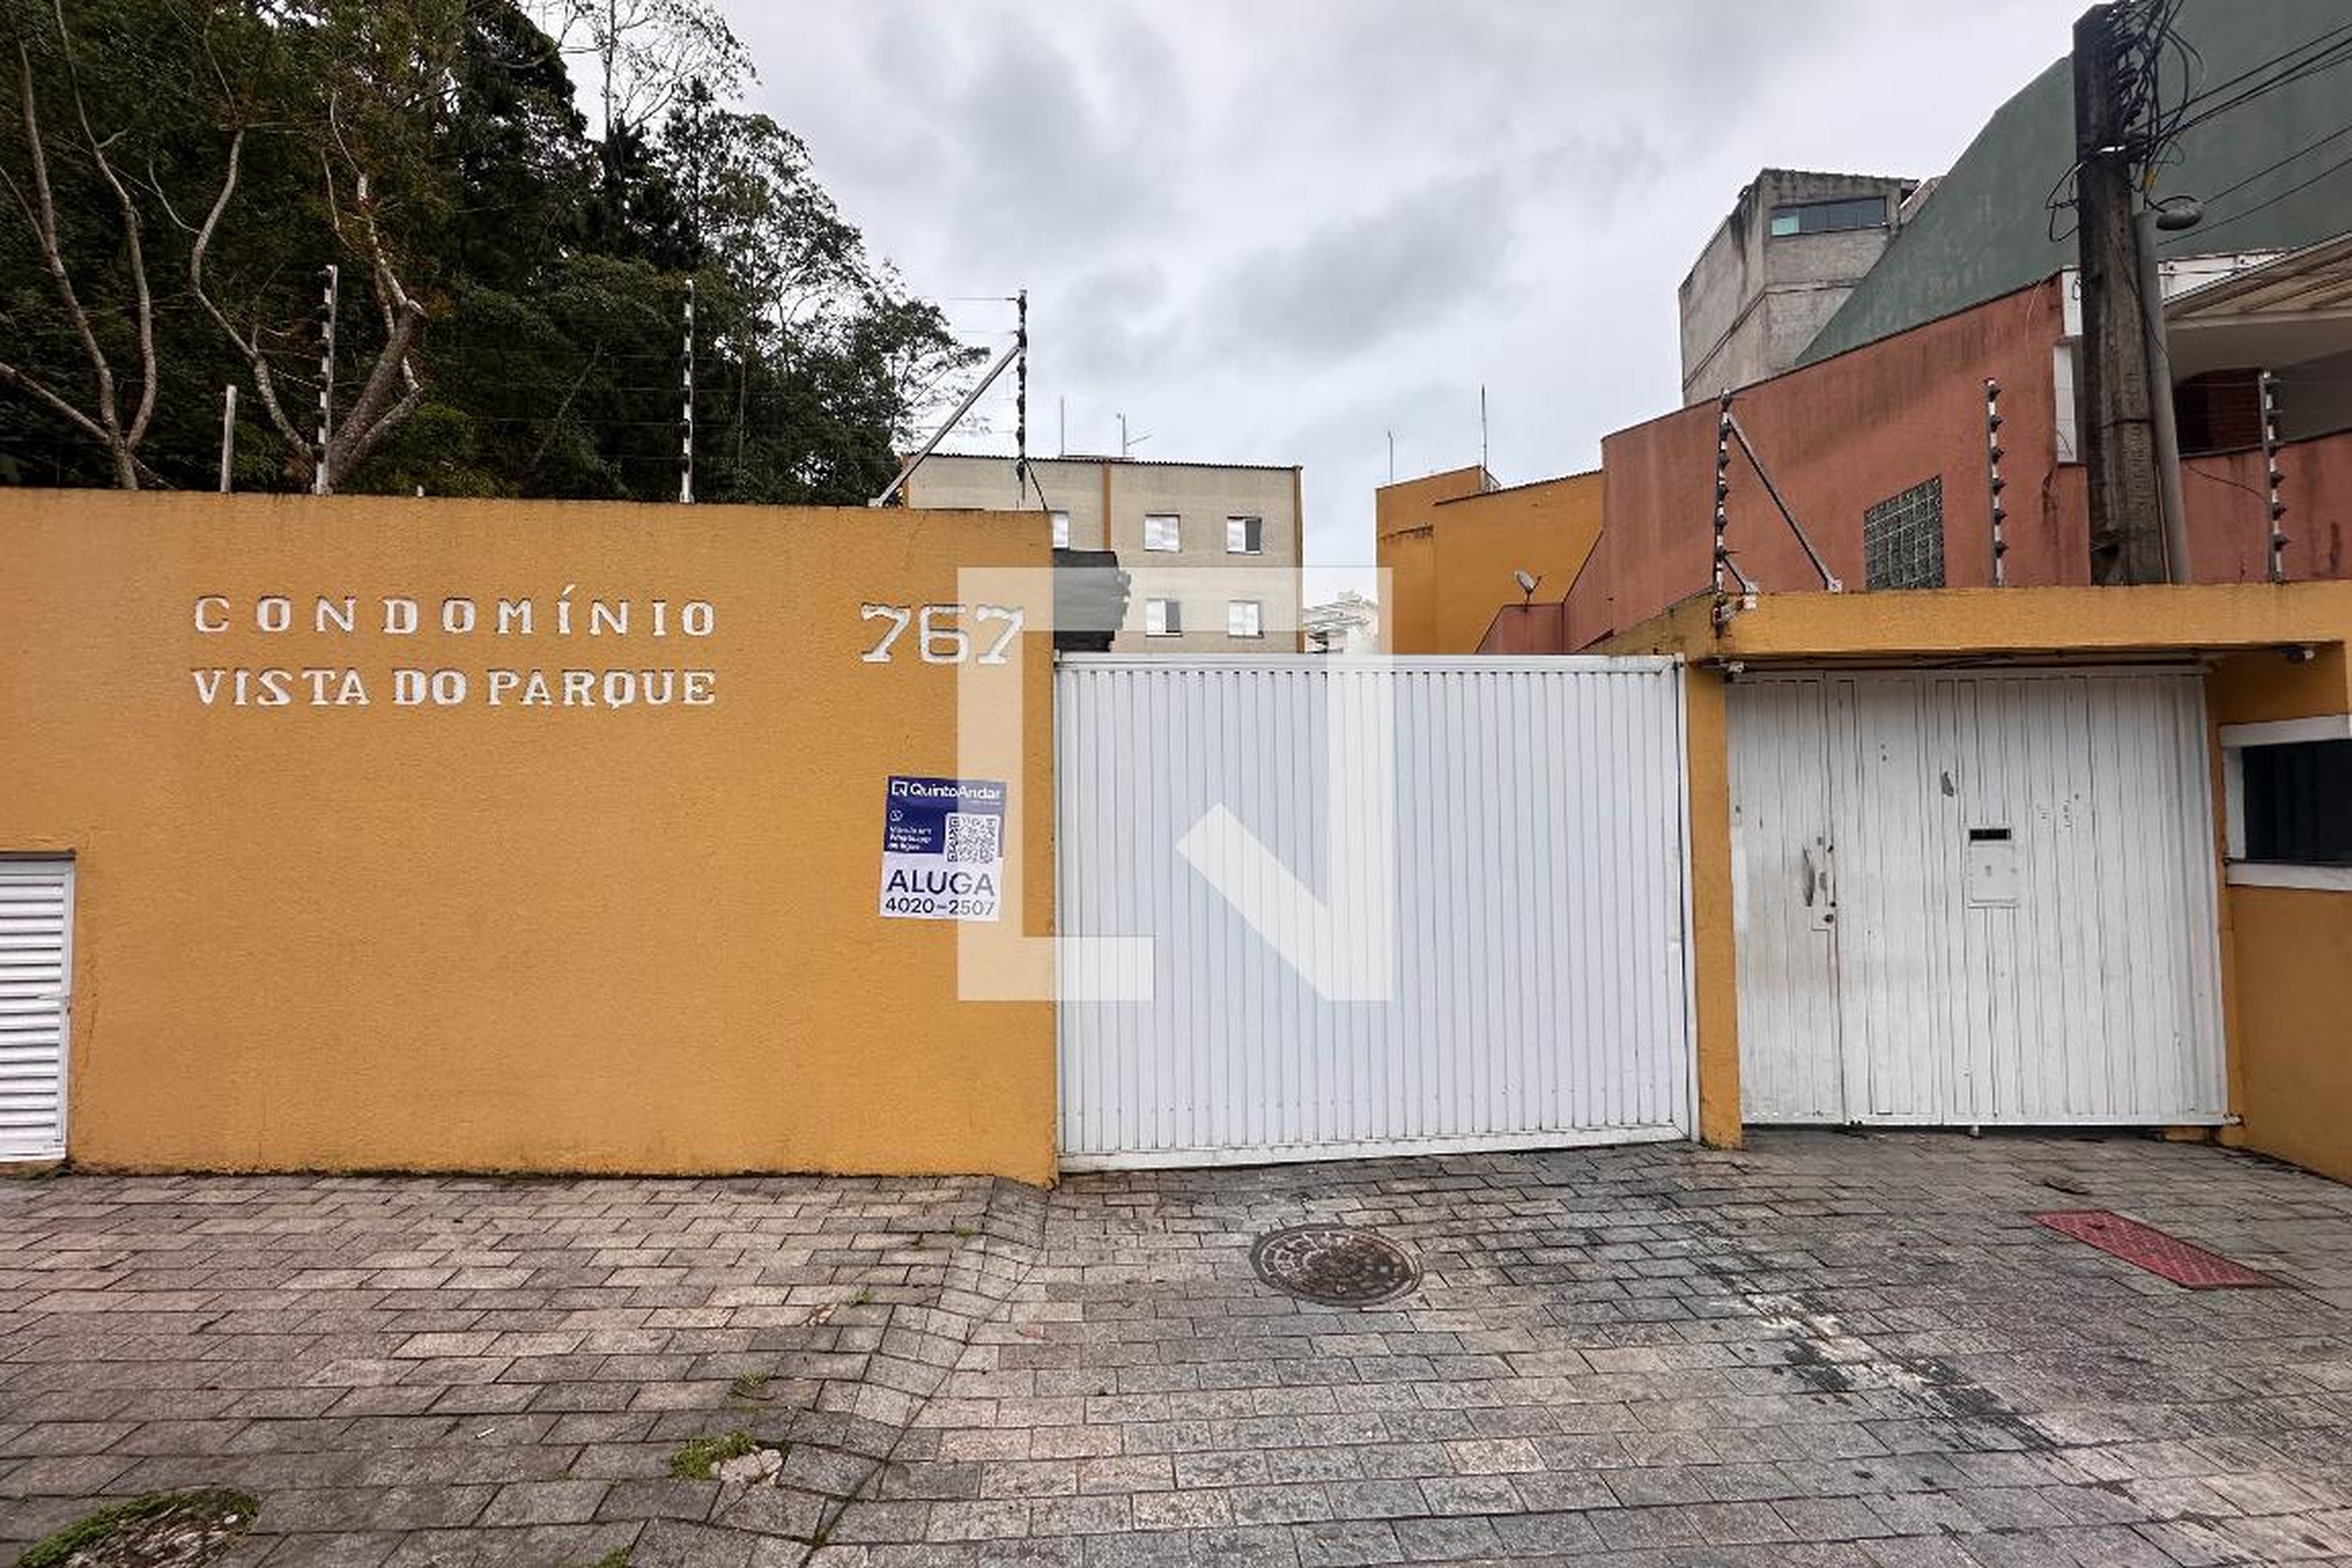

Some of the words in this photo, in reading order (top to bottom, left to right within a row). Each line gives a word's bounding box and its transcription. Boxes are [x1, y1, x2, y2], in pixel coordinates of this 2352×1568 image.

[194, 584, 716, 636] CONDOMÍNIO
[861, 602, 1023, 664] 767
[190, 669, 369, 706] VISTA
[391, 669, 468, 705] DO
[487, 669, 717, 708] PARQUE
[910, 783, 1000, 799] QuintoAndar
[886, 869, 995, 896] ALUGA
[885, 897, 994, 915] 4020-2507
